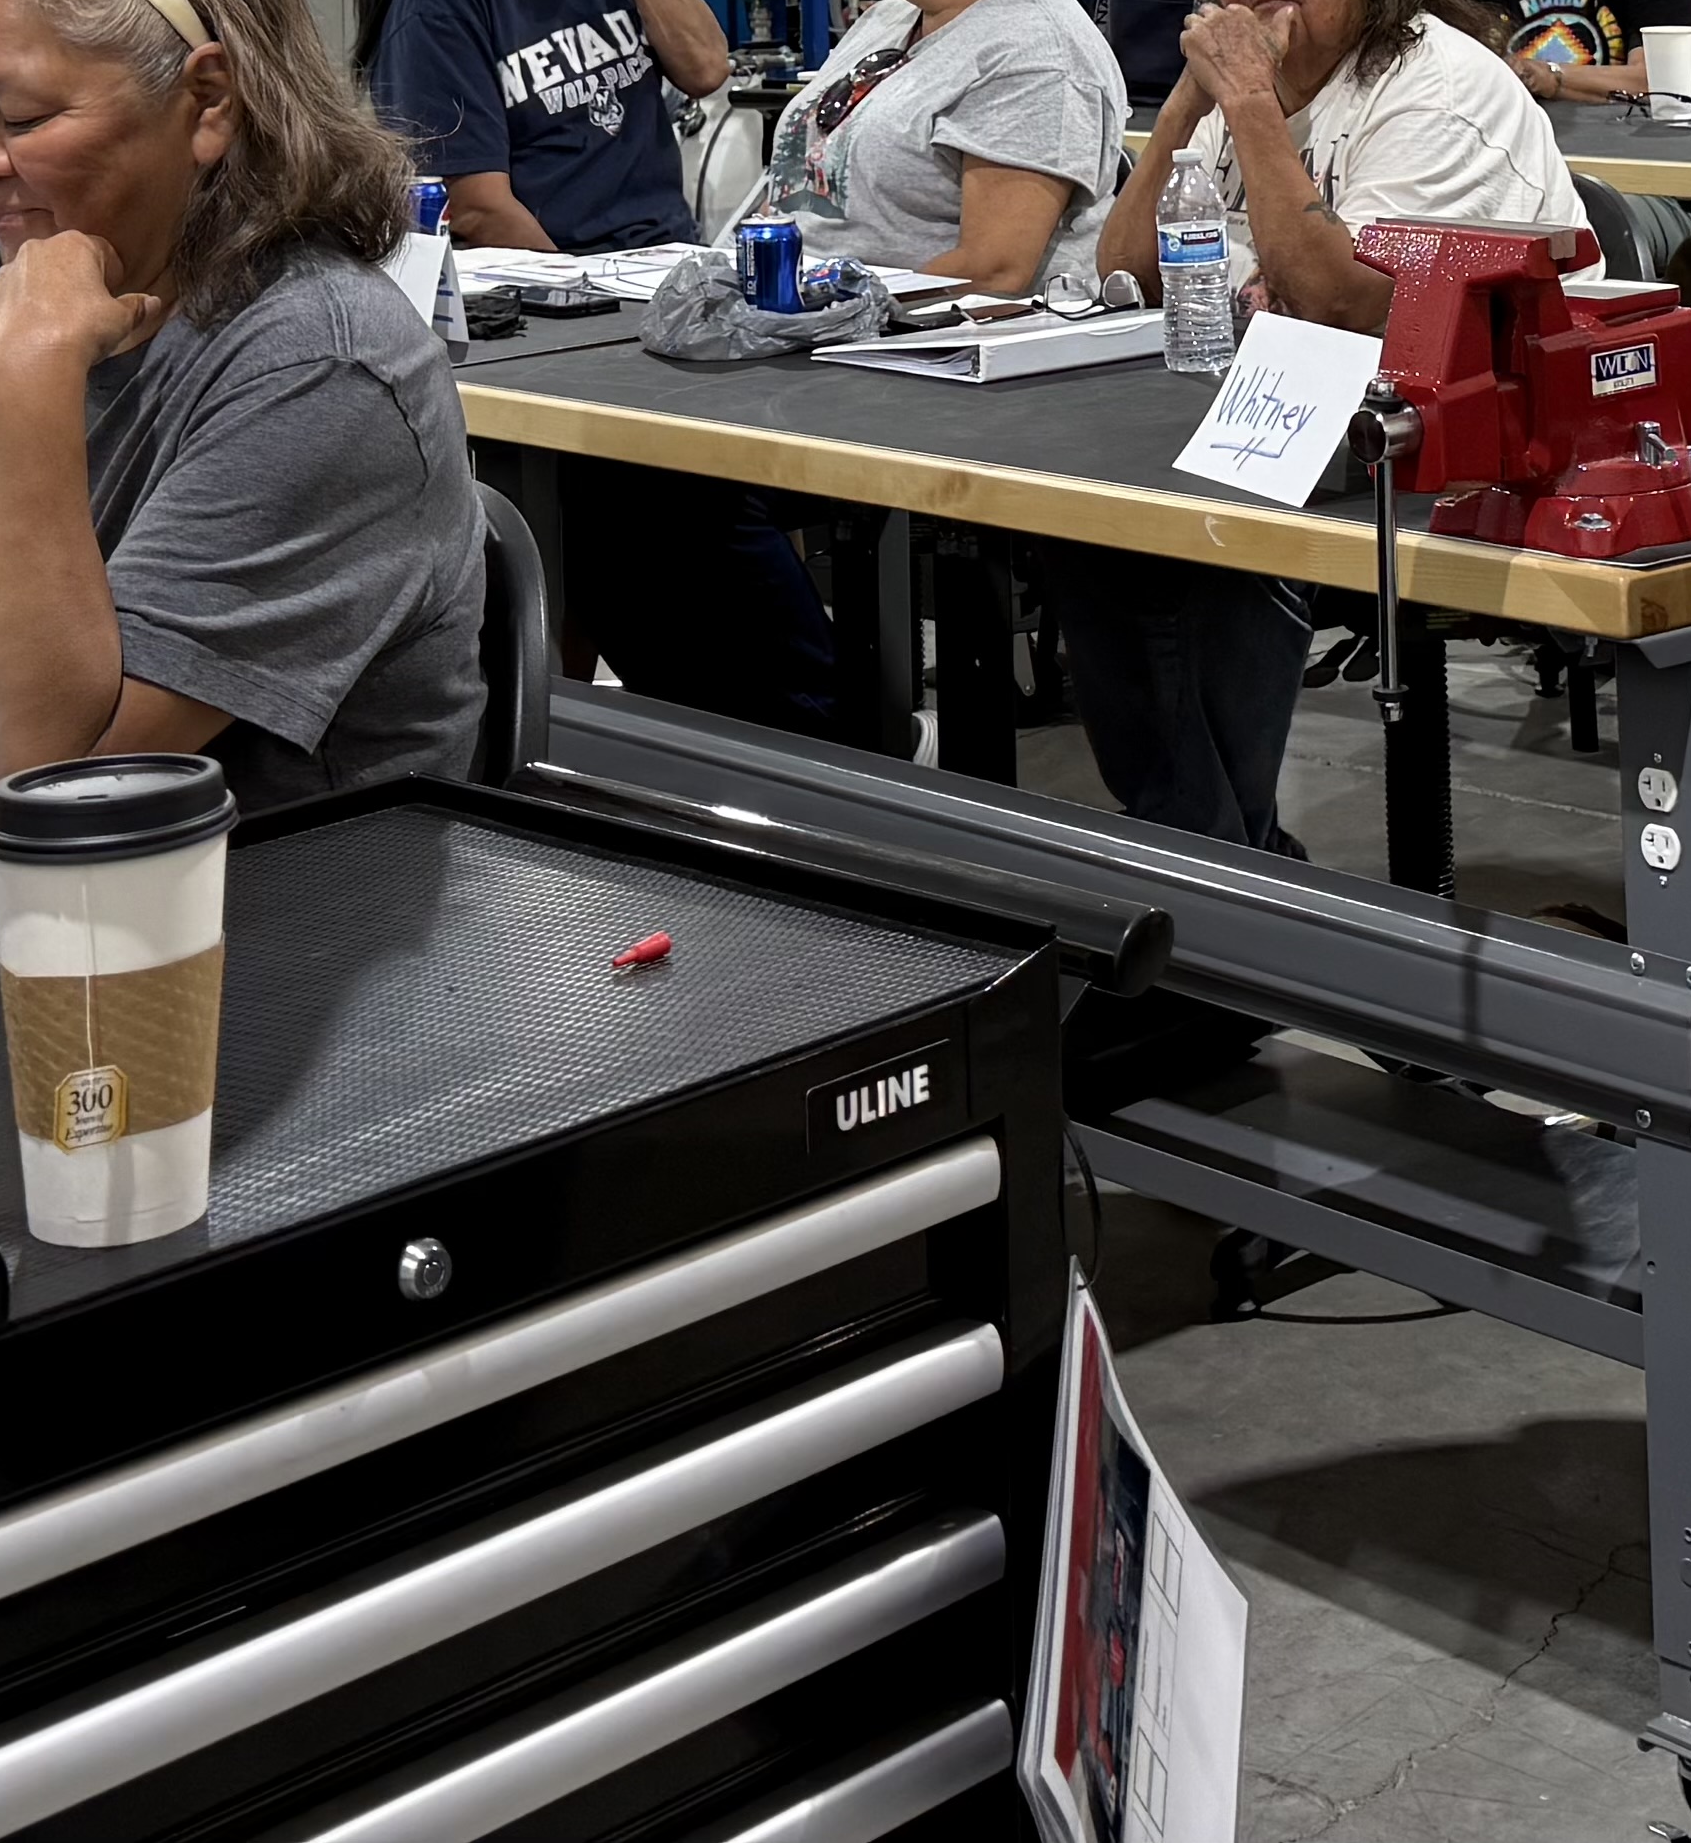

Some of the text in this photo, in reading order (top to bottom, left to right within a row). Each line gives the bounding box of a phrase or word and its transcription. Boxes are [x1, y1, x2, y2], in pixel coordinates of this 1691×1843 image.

[496, 9, 649, 109] NEVAD
[1216, 365, 1318, 458] Whitney
[66, 1083, 113, 1116] 300
[836, 1063, 930, 1132] ULINE
